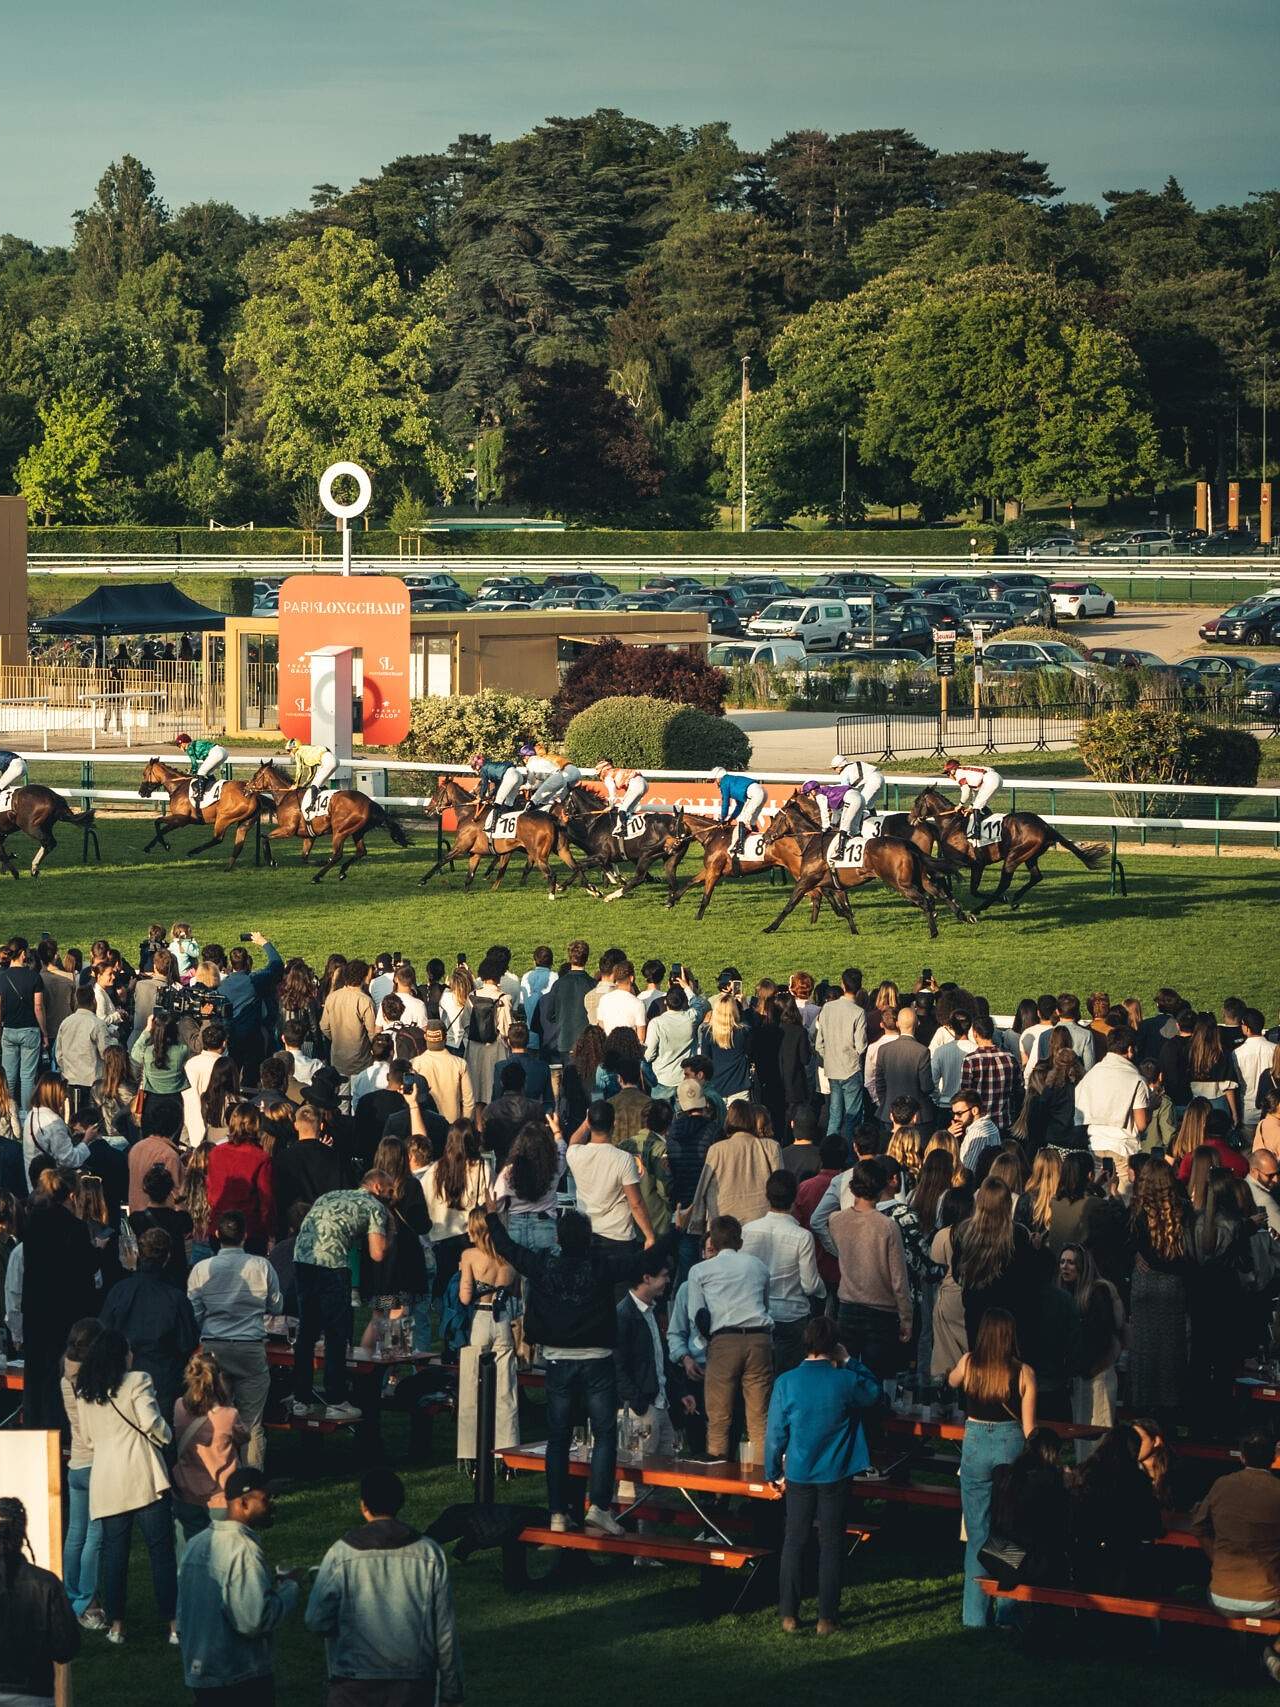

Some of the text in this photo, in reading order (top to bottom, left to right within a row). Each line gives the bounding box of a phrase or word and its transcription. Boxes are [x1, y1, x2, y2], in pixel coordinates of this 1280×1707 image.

[283, 601, 405, 615] PARISLONGCHAMP
[213, 785, 220, 800] 4
[316, 795, 329, 811] 14
[499, 817, 515, 833] 16
[872, 821, 881, 837] 3
[755, 838, 764, 856] 8
[846, 844, 863, 862] 13
